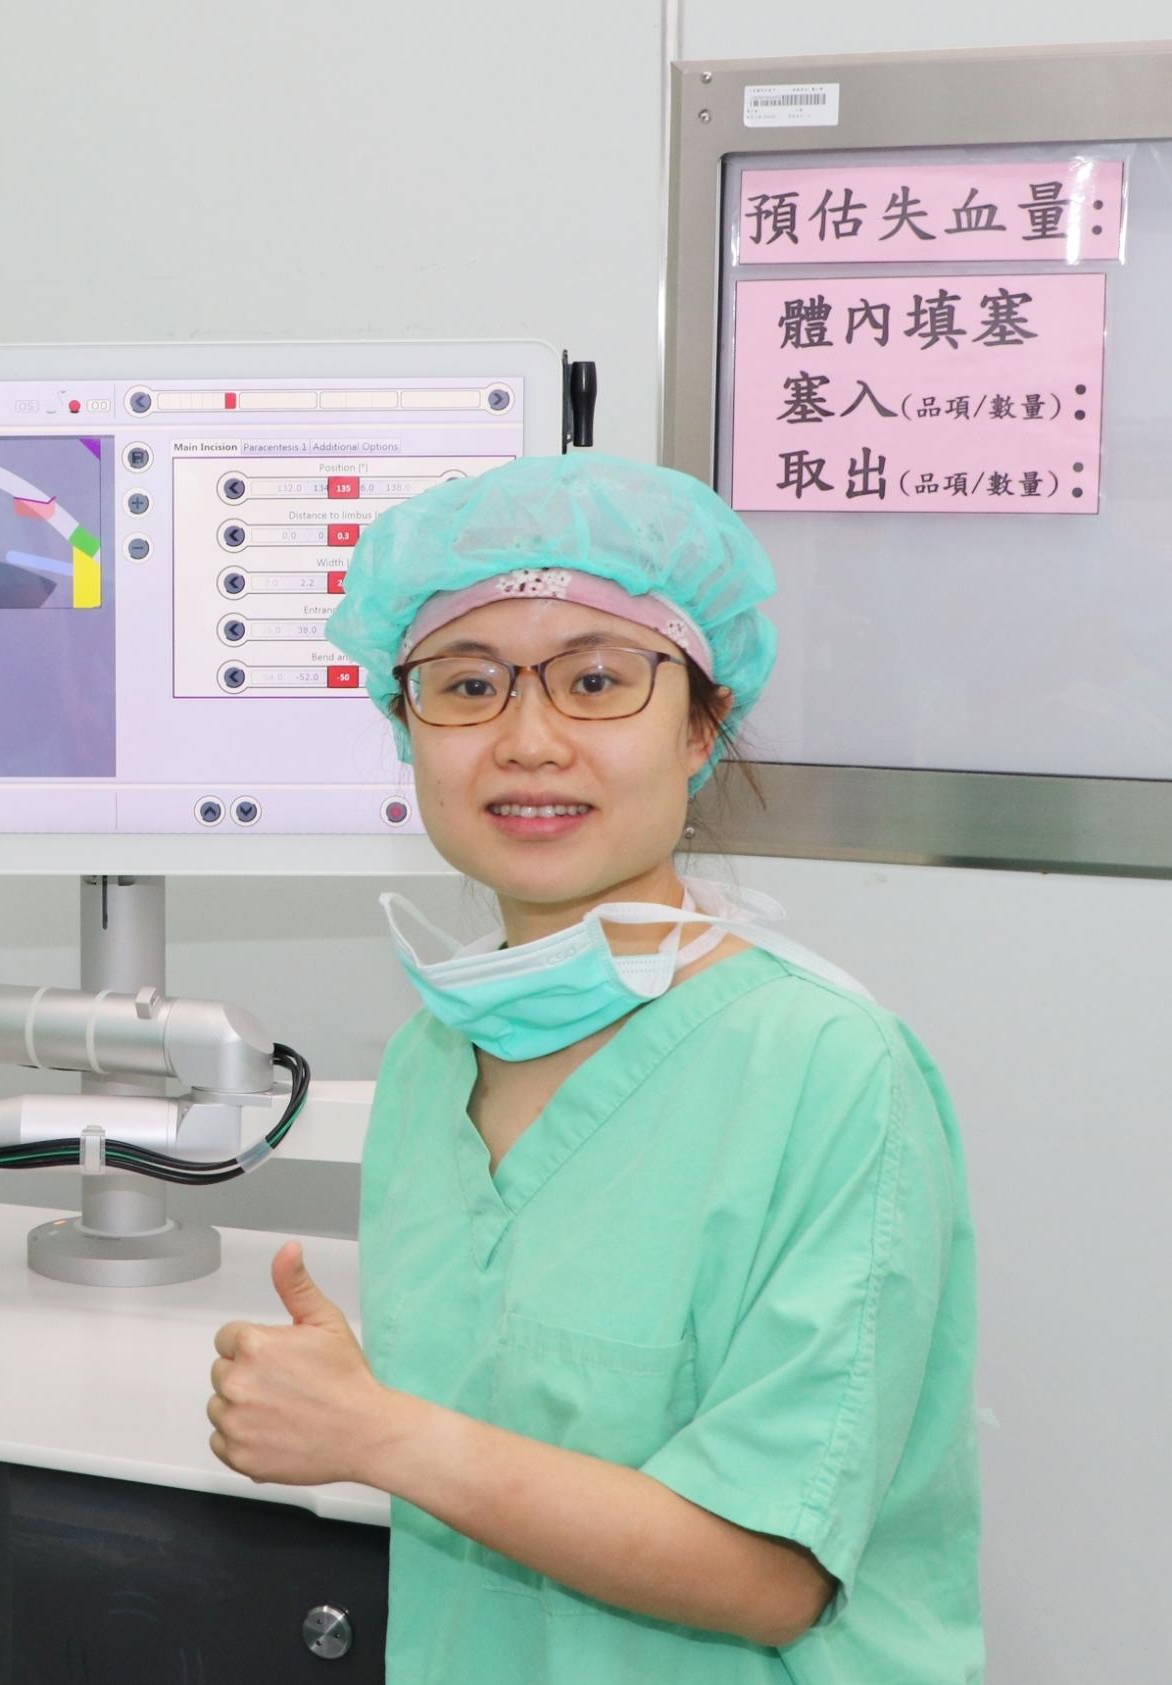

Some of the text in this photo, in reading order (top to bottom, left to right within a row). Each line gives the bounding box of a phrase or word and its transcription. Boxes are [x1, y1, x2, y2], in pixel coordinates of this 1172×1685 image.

[777, 287, 1038, 350] 體內填塞
[174, 442, 238, 452] Main Incision
[243, 442, 299, 452] Paracentesis
[313, 441, 398, 453] Additional Options
[319, 462, 356, 472] Position
[336, 484, 352, 493] 135
[288, 510, 327, 521] Distance
[329, 511, 339, 521] to
[341, 510, 372, 521] limbus
[336, 532, 350, 541] 0.3
[316, 558, 344, 567] Width
[299, 578, 315, 587] 2.2
[311, 652, 335, 662] Bend
[295, 672, 320, 682] -52.0
[337, 673, 350, 682] -50
